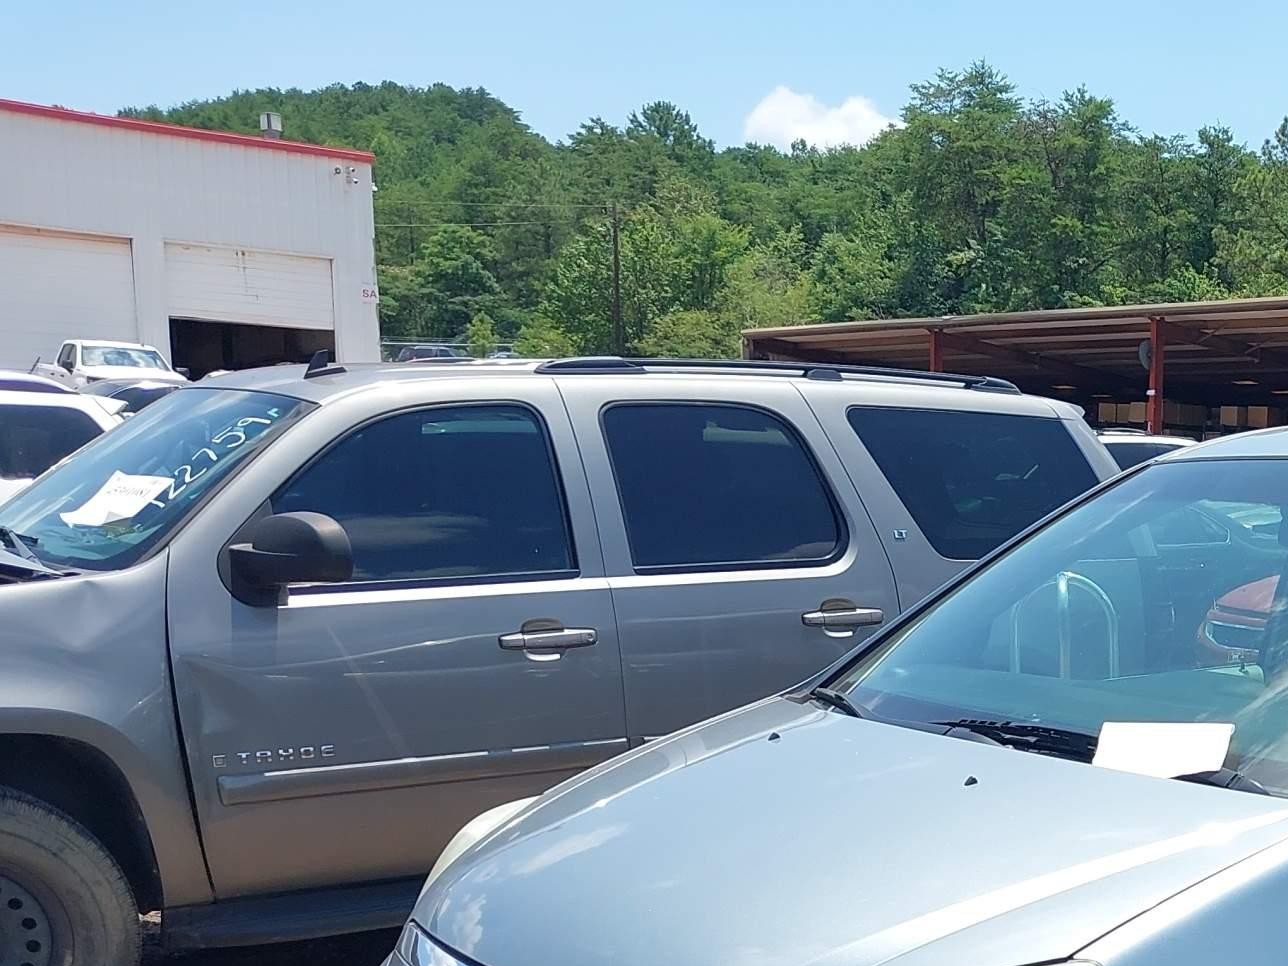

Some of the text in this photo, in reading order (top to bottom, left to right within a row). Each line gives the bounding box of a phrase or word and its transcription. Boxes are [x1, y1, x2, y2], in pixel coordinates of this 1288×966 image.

[151, 416, 272, 509] 22759
[894, 529, 907, 539] LT
[237, 745, 335, 764] TAHOE
